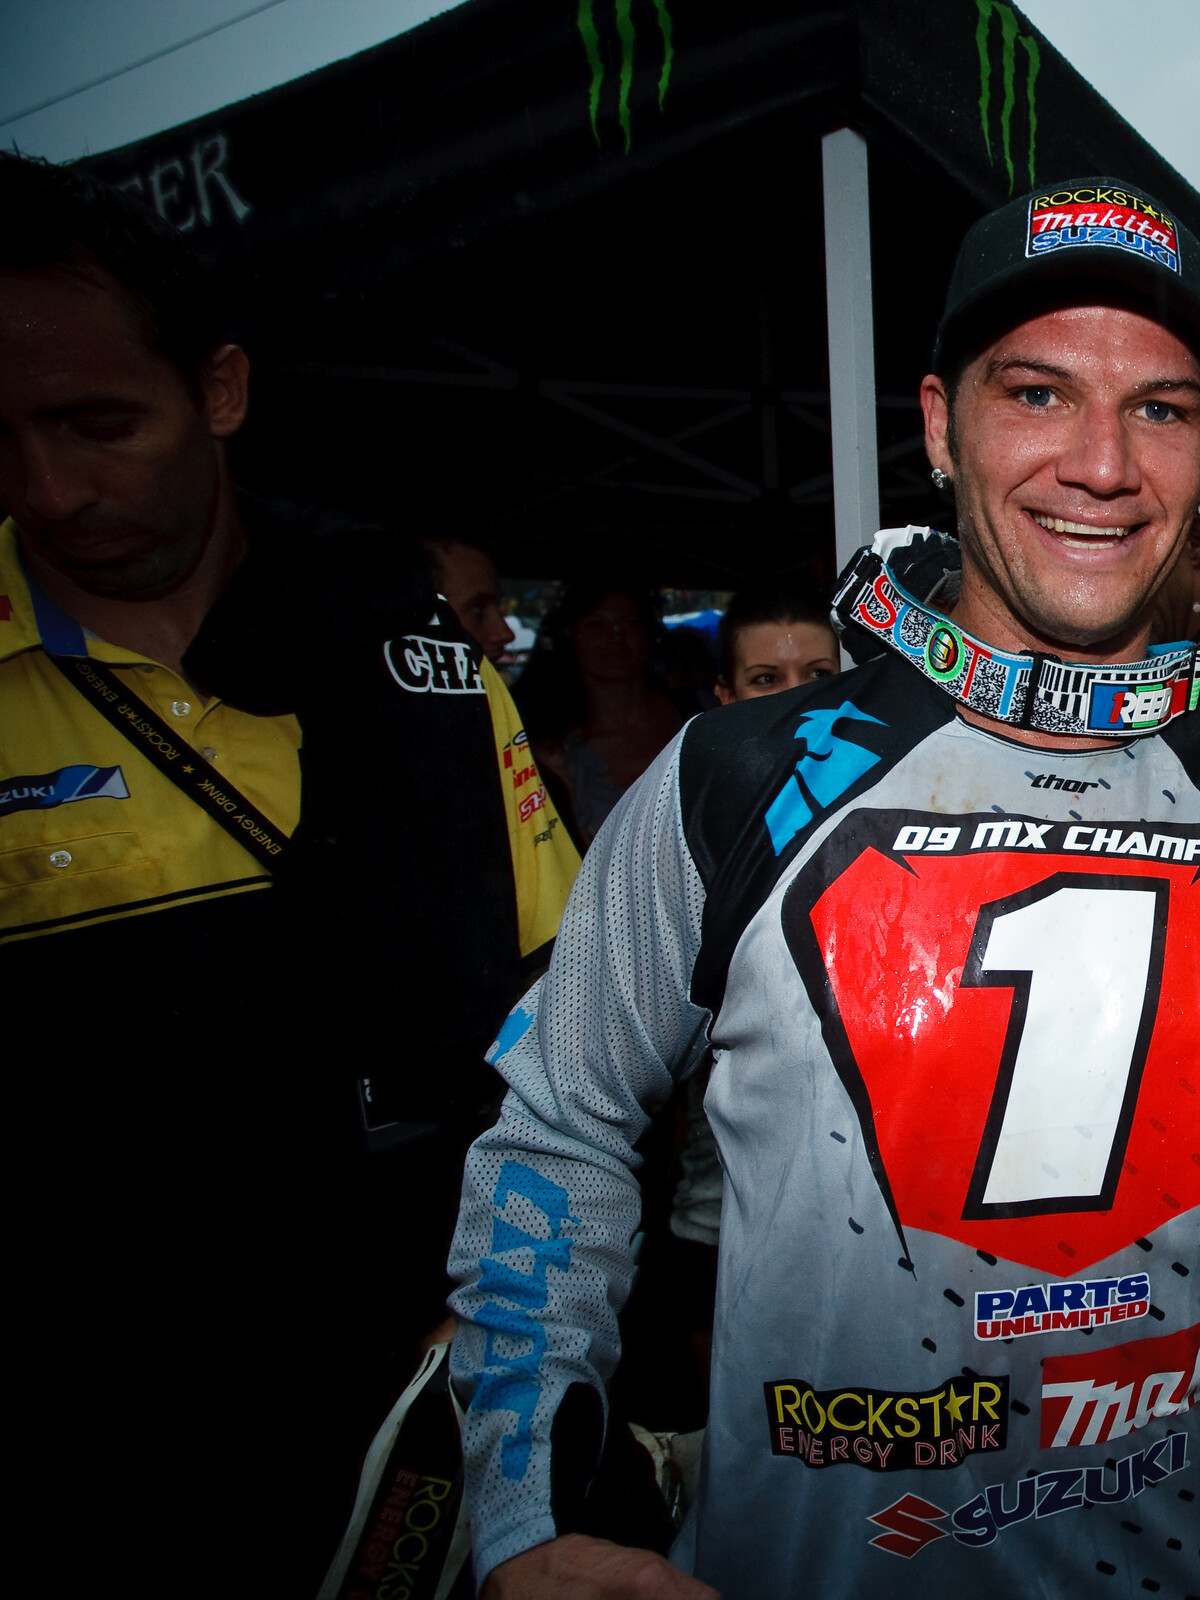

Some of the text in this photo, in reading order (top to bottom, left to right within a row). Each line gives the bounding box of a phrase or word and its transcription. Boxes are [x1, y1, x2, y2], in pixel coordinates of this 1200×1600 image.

[1032, 226, 1177, 272] SUZUKI
[189, 778, 238, 819] DRINK
[1031, 774, 1099, 794] thor
[234, 811, 284, 856] ENERGY
[892, 824, 962, 852] 09
[970, 820, 1055, 850] MX
[978, 884, 1160, 1207] 1
[976, 1273, 1150, 1321] PARTS
[976, 1300, 1149, 1339] UNLIMITED
[779, 1423, 1001, 1468] ENERGY DRINK
[951, 1432, 1189, 1548] SUZUKI
[358, 1469, 421, 1584] ENERGY
